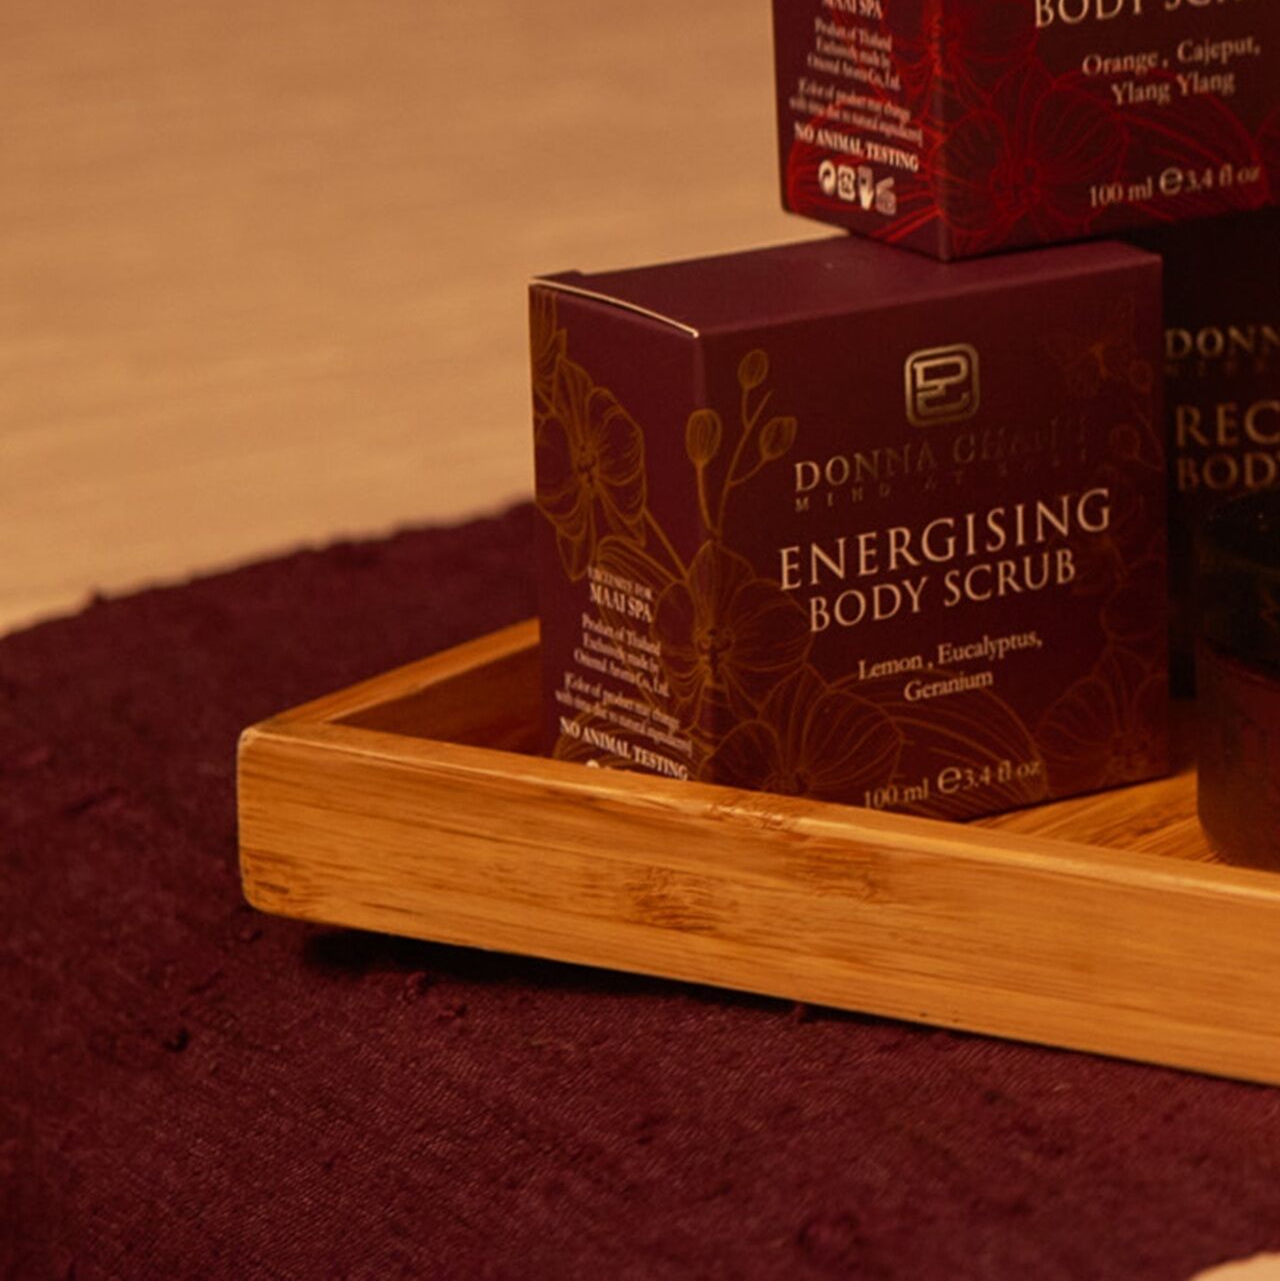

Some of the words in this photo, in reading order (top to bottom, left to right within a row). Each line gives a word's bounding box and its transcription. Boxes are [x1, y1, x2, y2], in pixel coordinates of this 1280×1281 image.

[1110, 77, 1171, 106] Ylang
[1175, 69, 1236, 98] Ylang
[794, 121, 815, 144] NO
[815, 129, 864, 158] ANIMAL
[864, 141, 920, 172] TESTING
[1088, 182, 1124, 208] 100
[1126, 175, 1154, 203] ml
[778, 487, 1113, 593] ENERGISING
[809, 574, 929, 633] BODY
[942, 546, 1077, 608] SCRUB
[627, 595, 653, 624] SPA
[937, 629, 1044, 667] Eucalyptus,
[903, 669, 995, 703] Geranium
[560, 716, 581, 739] NO
[581, 726, 632, 759] ANIMAL
[632, 745, 689, 782] TESTING
[863, 787, 902, 810] 100
[903, 778, 930, 804] ml
